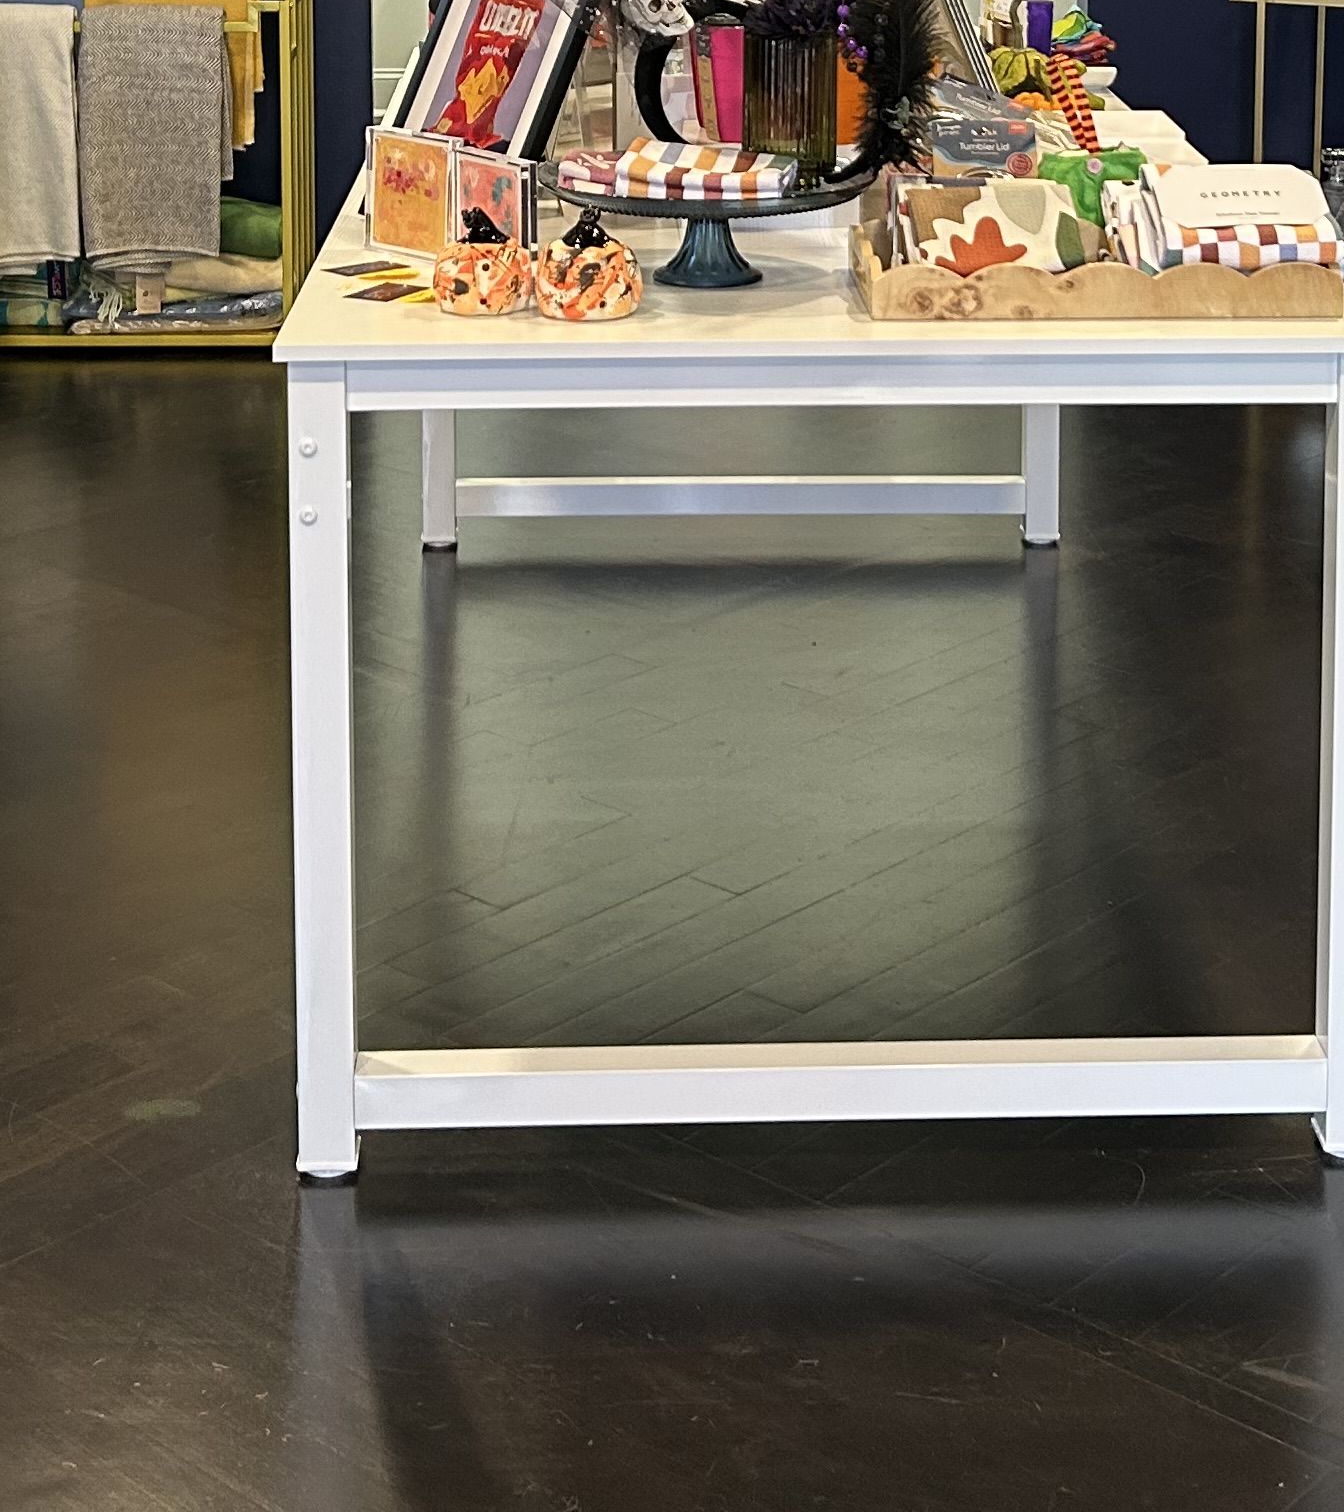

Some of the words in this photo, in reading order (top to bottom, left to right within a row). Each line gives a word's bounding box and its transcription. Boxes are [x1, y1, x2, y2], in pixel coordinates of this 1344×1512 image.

[959, 142, 994, 151] Tumbler
[996, 142, 1010, 151] Lid
[1200, 190, 1281, 198] GEOMETRY
